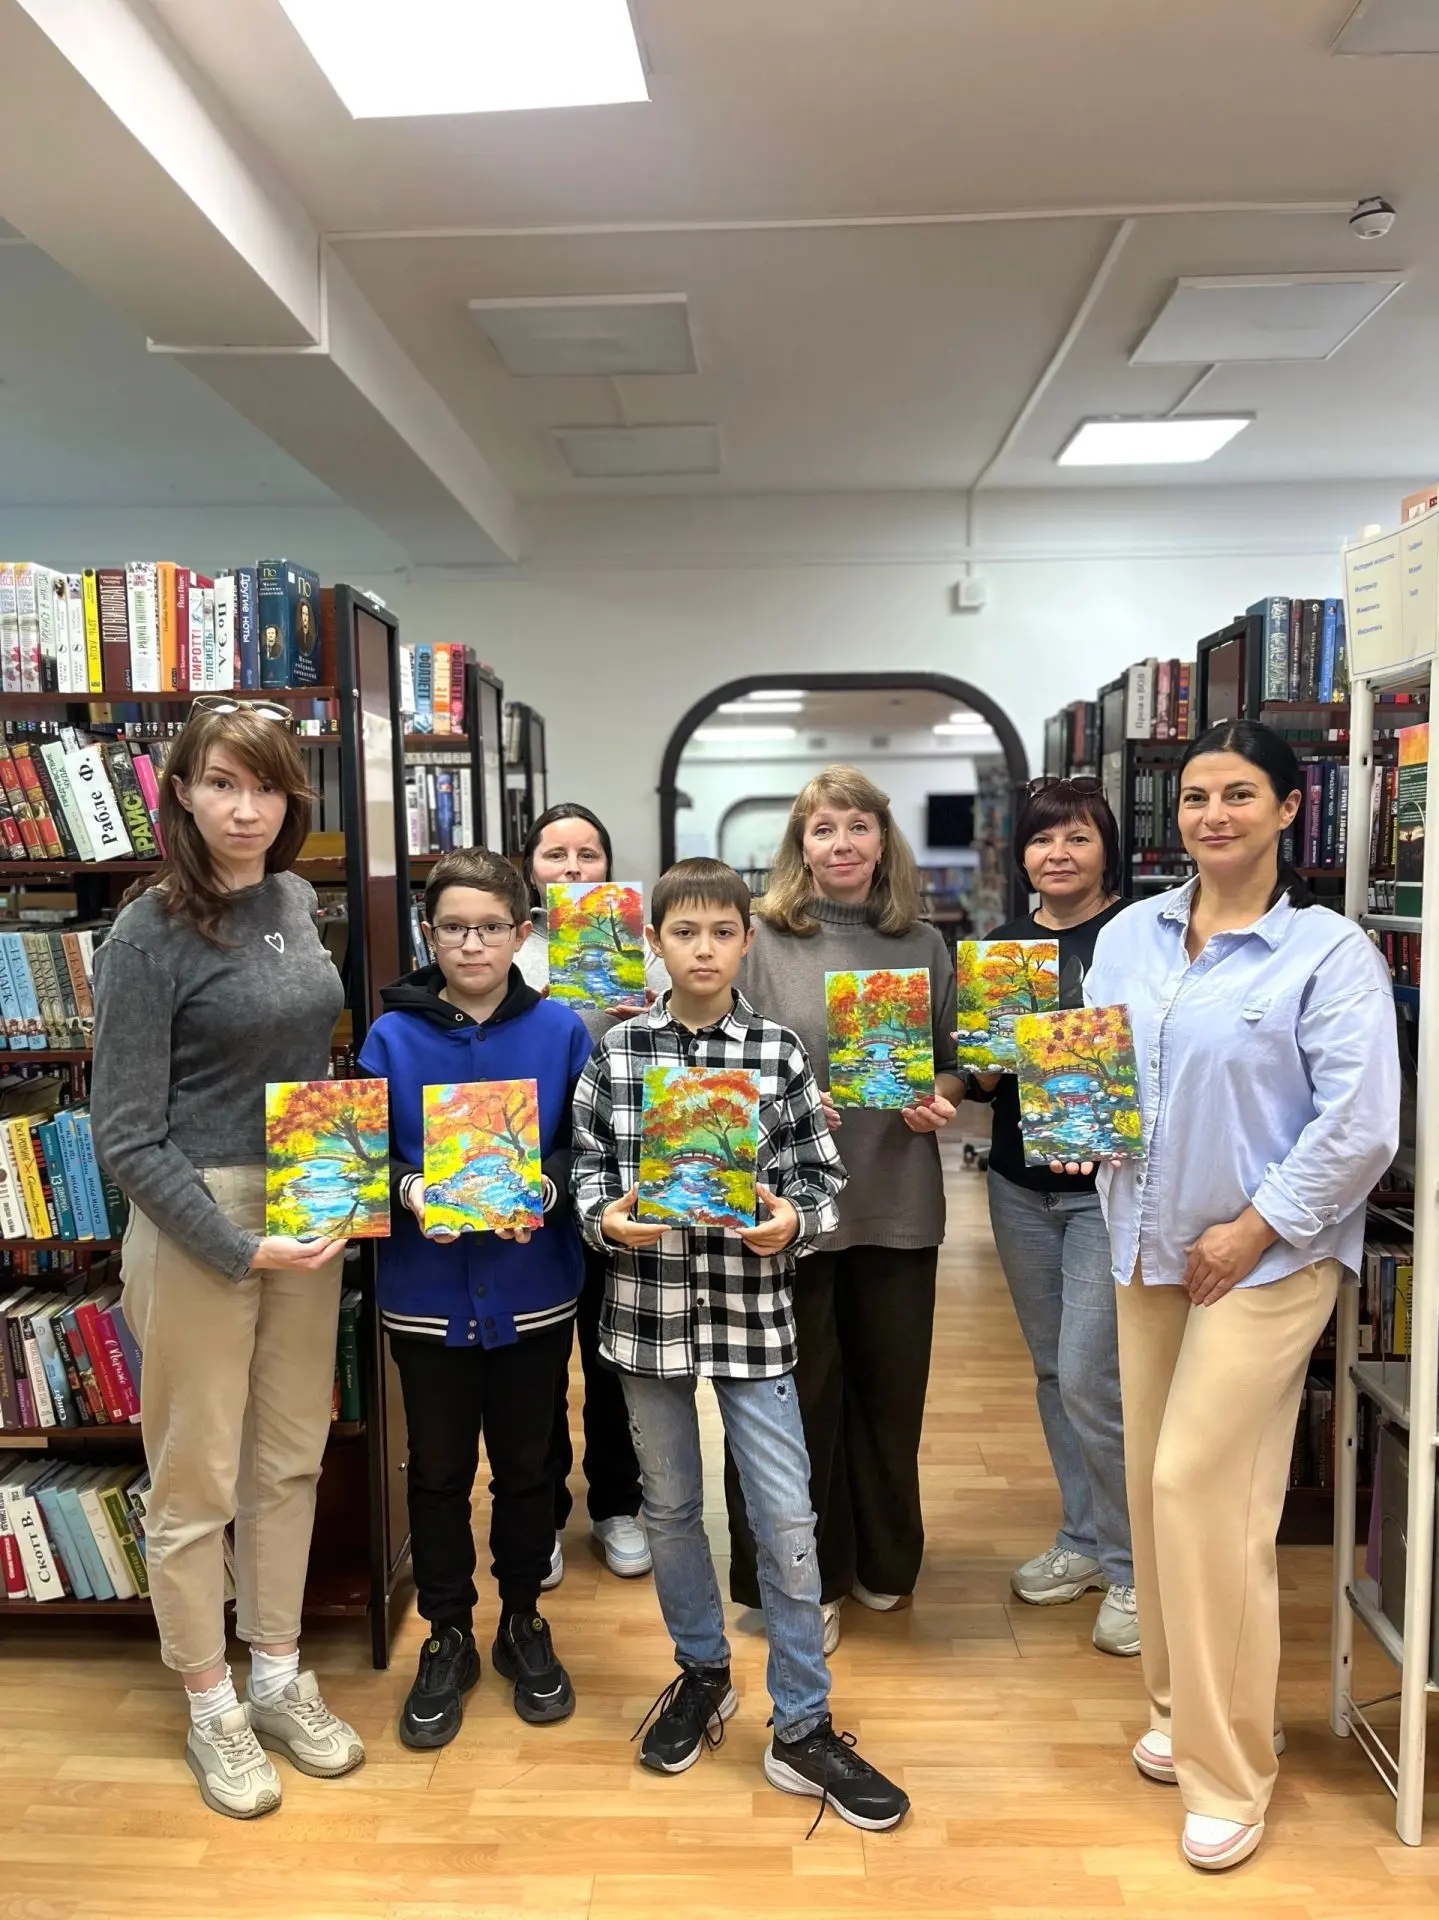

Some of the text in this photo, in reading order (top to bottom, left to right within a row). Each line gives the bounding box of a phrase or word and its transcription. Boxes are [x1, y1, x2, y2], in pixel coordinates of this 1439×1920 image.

[100, 584, 128, 643] КТО ВИНОВАТ
[217, 602, 228, 628] По
[240, 573, 252, 643] Другие ноты
[418, 652, 431, 699] ФОЛЛЕТТ
[78, 757, 119, 846] Рабле Ф.
[53, 1389, 67, 1421] Свифт
[22, 1510, 51, 1583] Скотт В.
